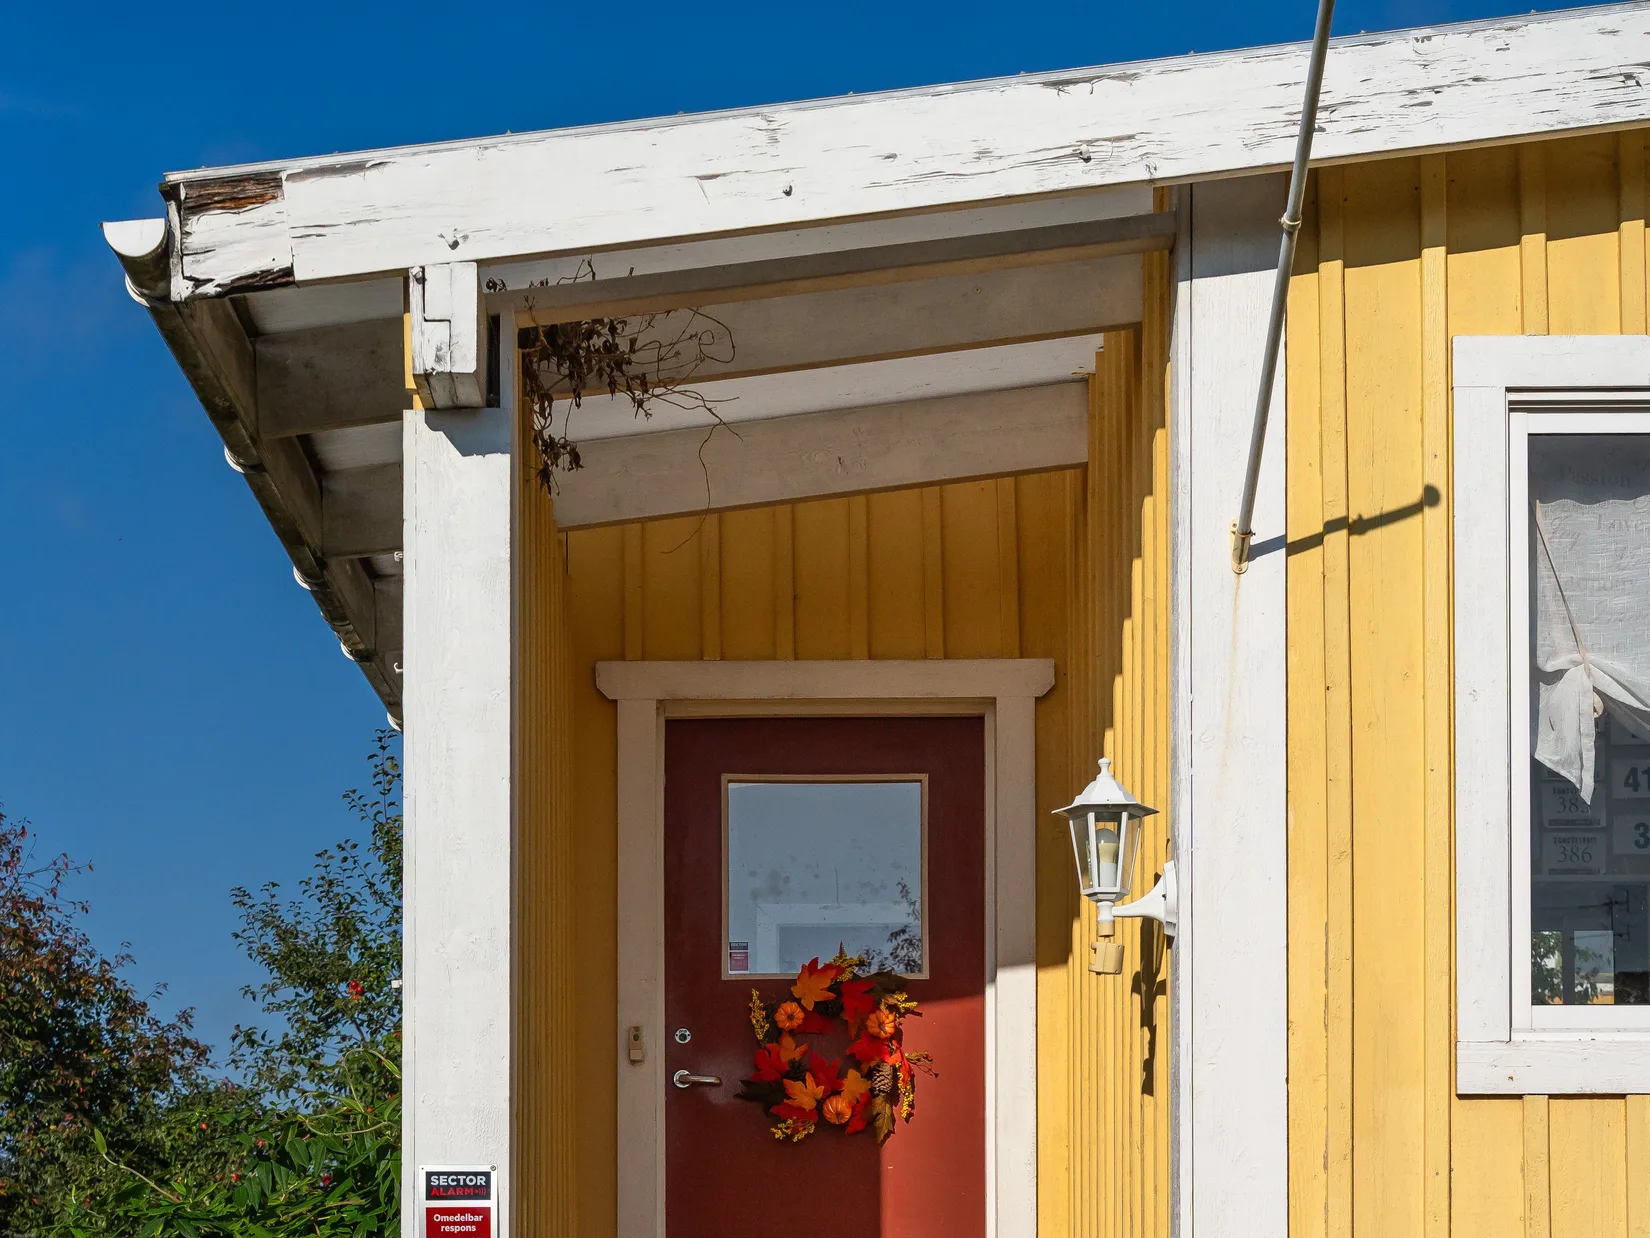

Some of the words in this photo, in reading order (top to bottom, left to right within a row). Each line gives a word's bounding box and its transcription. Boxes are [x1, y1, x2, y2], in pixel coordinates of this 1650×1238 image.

[1556, 845, 1593, 863] 386
[430, 1175, 486, 1186] SECTOR
[430, 1187, 474, 1196] ALARM
[433, 1213, 483, 1222] Omedelbar
[440, 1224, 477, 1233] respons
